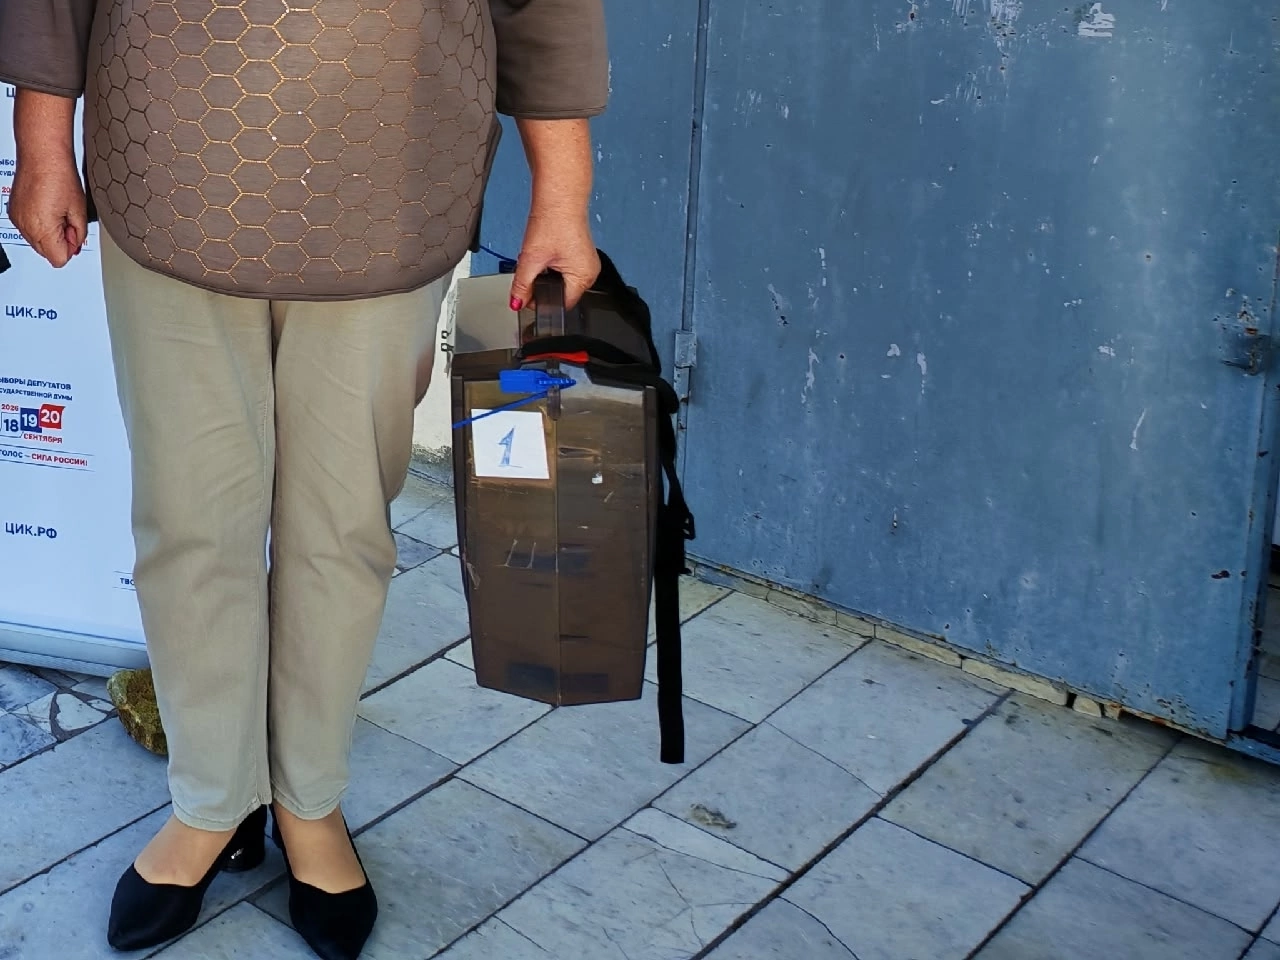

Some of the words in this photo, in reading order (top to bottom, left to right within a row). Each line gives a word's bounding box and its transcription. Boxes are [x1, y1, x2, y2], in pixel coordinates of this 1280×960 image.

[5, 305, 58, 320] ЦИК.РФ
[27, 379, 72, 390] ДЕПУТАТОВ
[1, 403, 19, 411] 2026
[3, 418, 19, 432] 18
[21, 413, 38, 428] 19
[41, 409, 60, 424] 20
[23, 433, 63, 443] СЕНТЯБРЯ
[497, 425, 523, 468] 1
[31, 452, 52, 463] СИЛА
[5, 521, 58, 539] ЦИК.РФ
